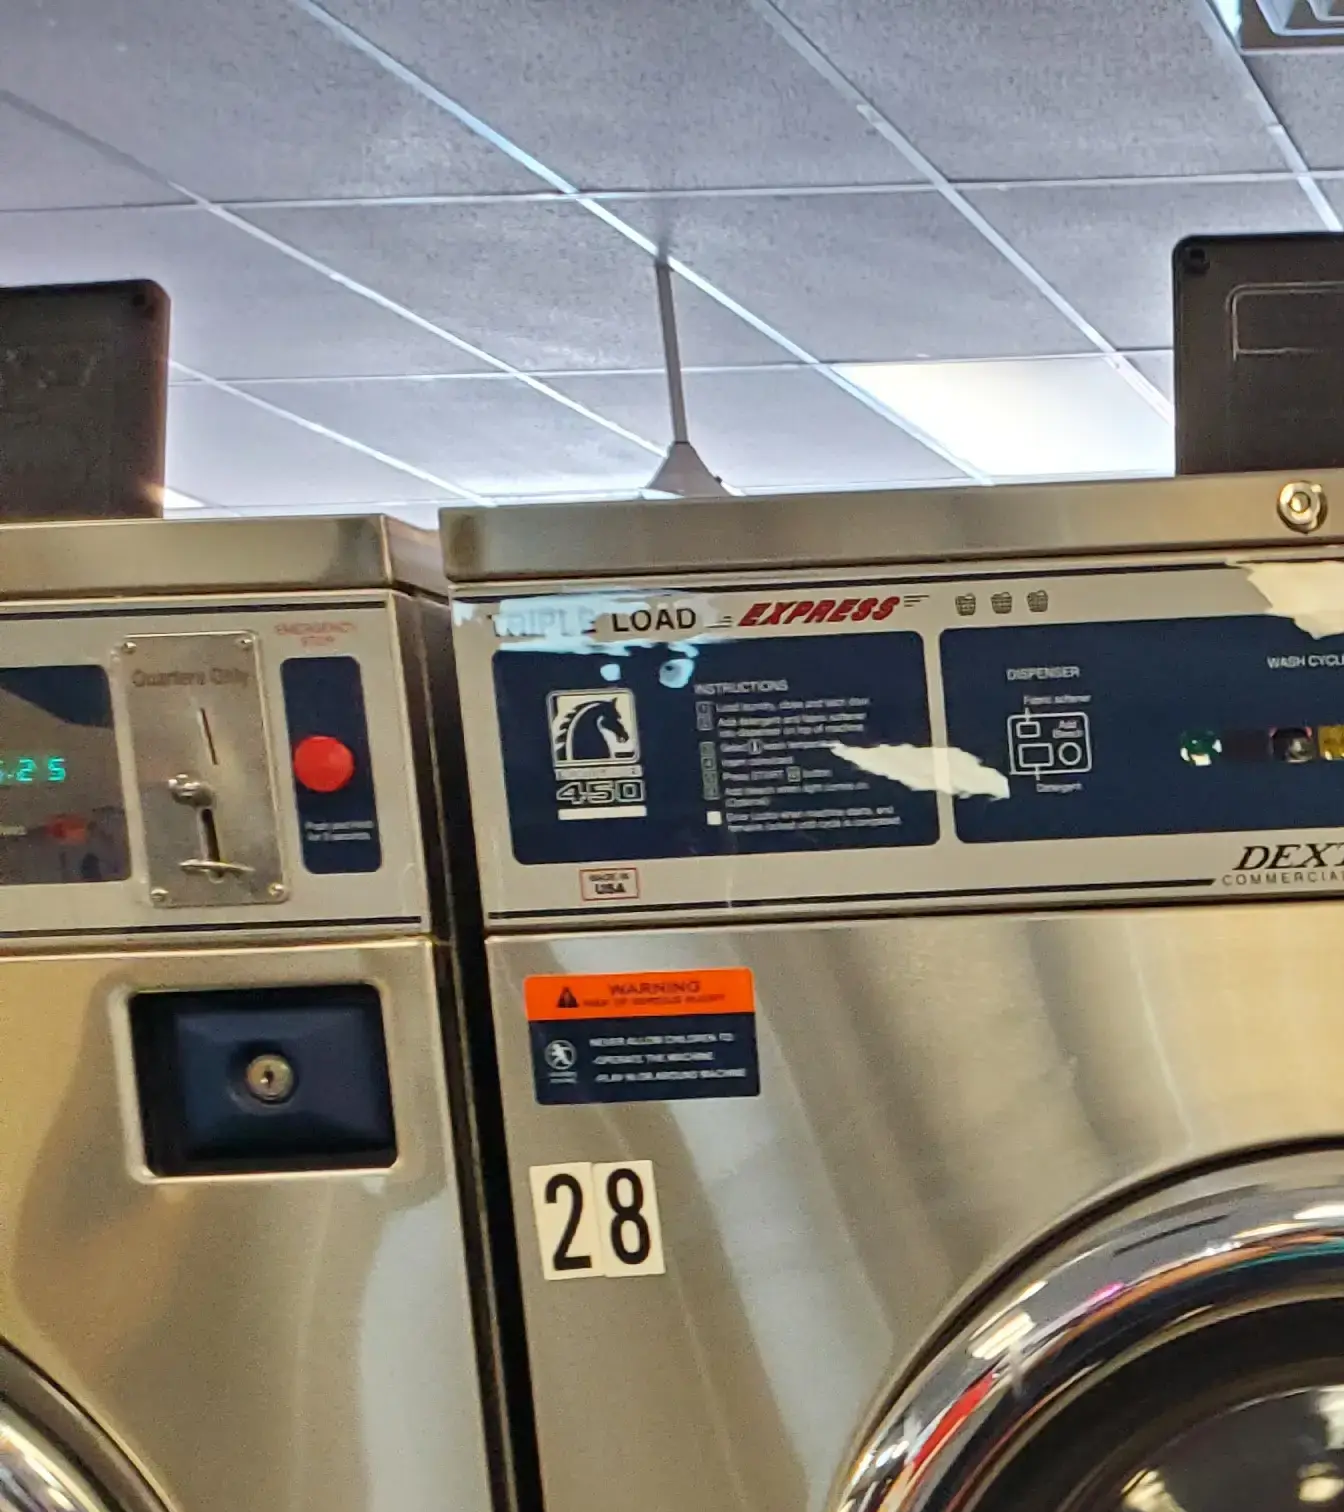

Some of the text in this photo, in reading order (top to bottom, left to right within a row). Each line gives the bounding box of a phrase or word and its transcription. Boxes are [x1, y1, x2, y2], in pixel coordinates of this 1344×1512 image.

[612, 608, 696, 632] LOAD
[738, 596, 900, 626] EXPRESS
[1267, 656, 1305, 668] WASH
[133, 669, 205, 687] Quarters
[1006, 666, 1080, 680] DISPENSER
[694, 680, 789, 694] INSTRUCTIONS
[556, 780, 644, 804] 450
[608, 981, 701, 994] WARNING
[545, 1168, 652, 1271] 28
